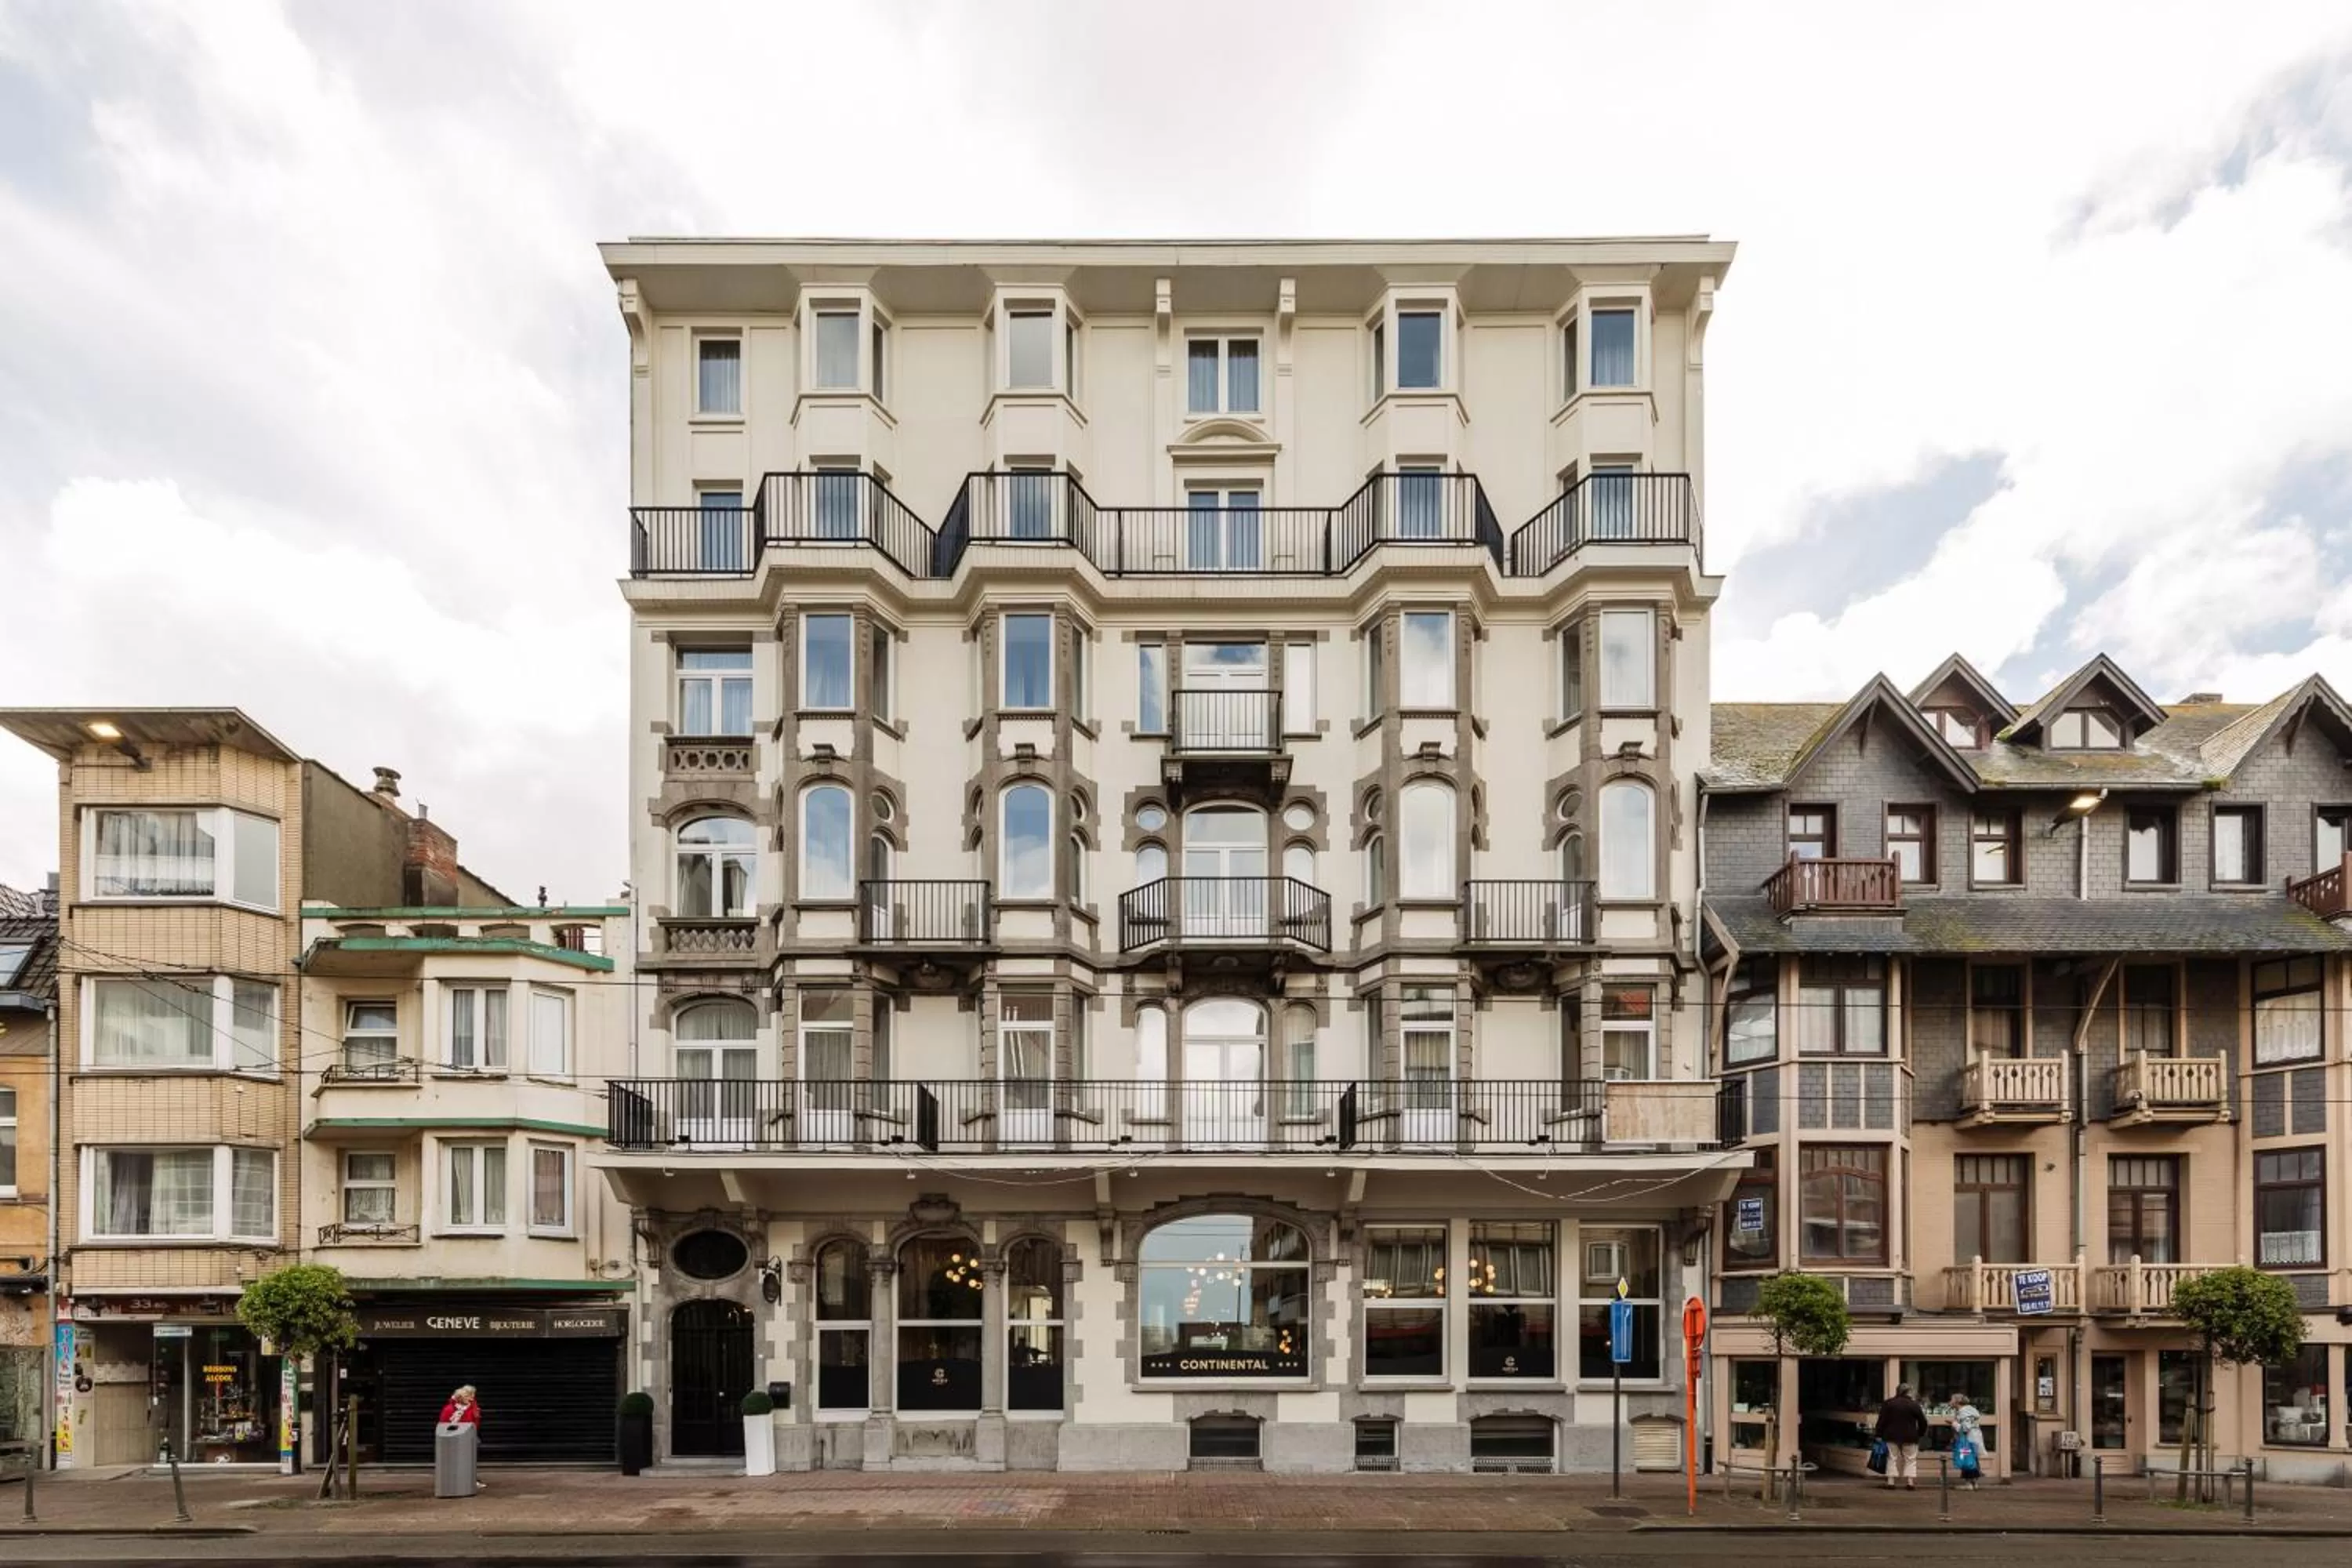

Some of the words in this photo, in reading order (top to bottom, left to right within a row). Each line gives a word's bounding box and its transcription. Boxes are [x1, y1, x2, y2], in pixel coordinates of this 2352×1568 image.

[2018, 1275, 2027, 1285] TE
[2027, 1272, 2047, 1283] KOOP
[426, 1316, 480, 1329] GENEVE
[489, 1319, 535, 1330] BIJOUTERIE
[554, 1319, 605, 1329] HORLOGERIE
[1180, 1359, 1269, 1370] CONTINENTAL
